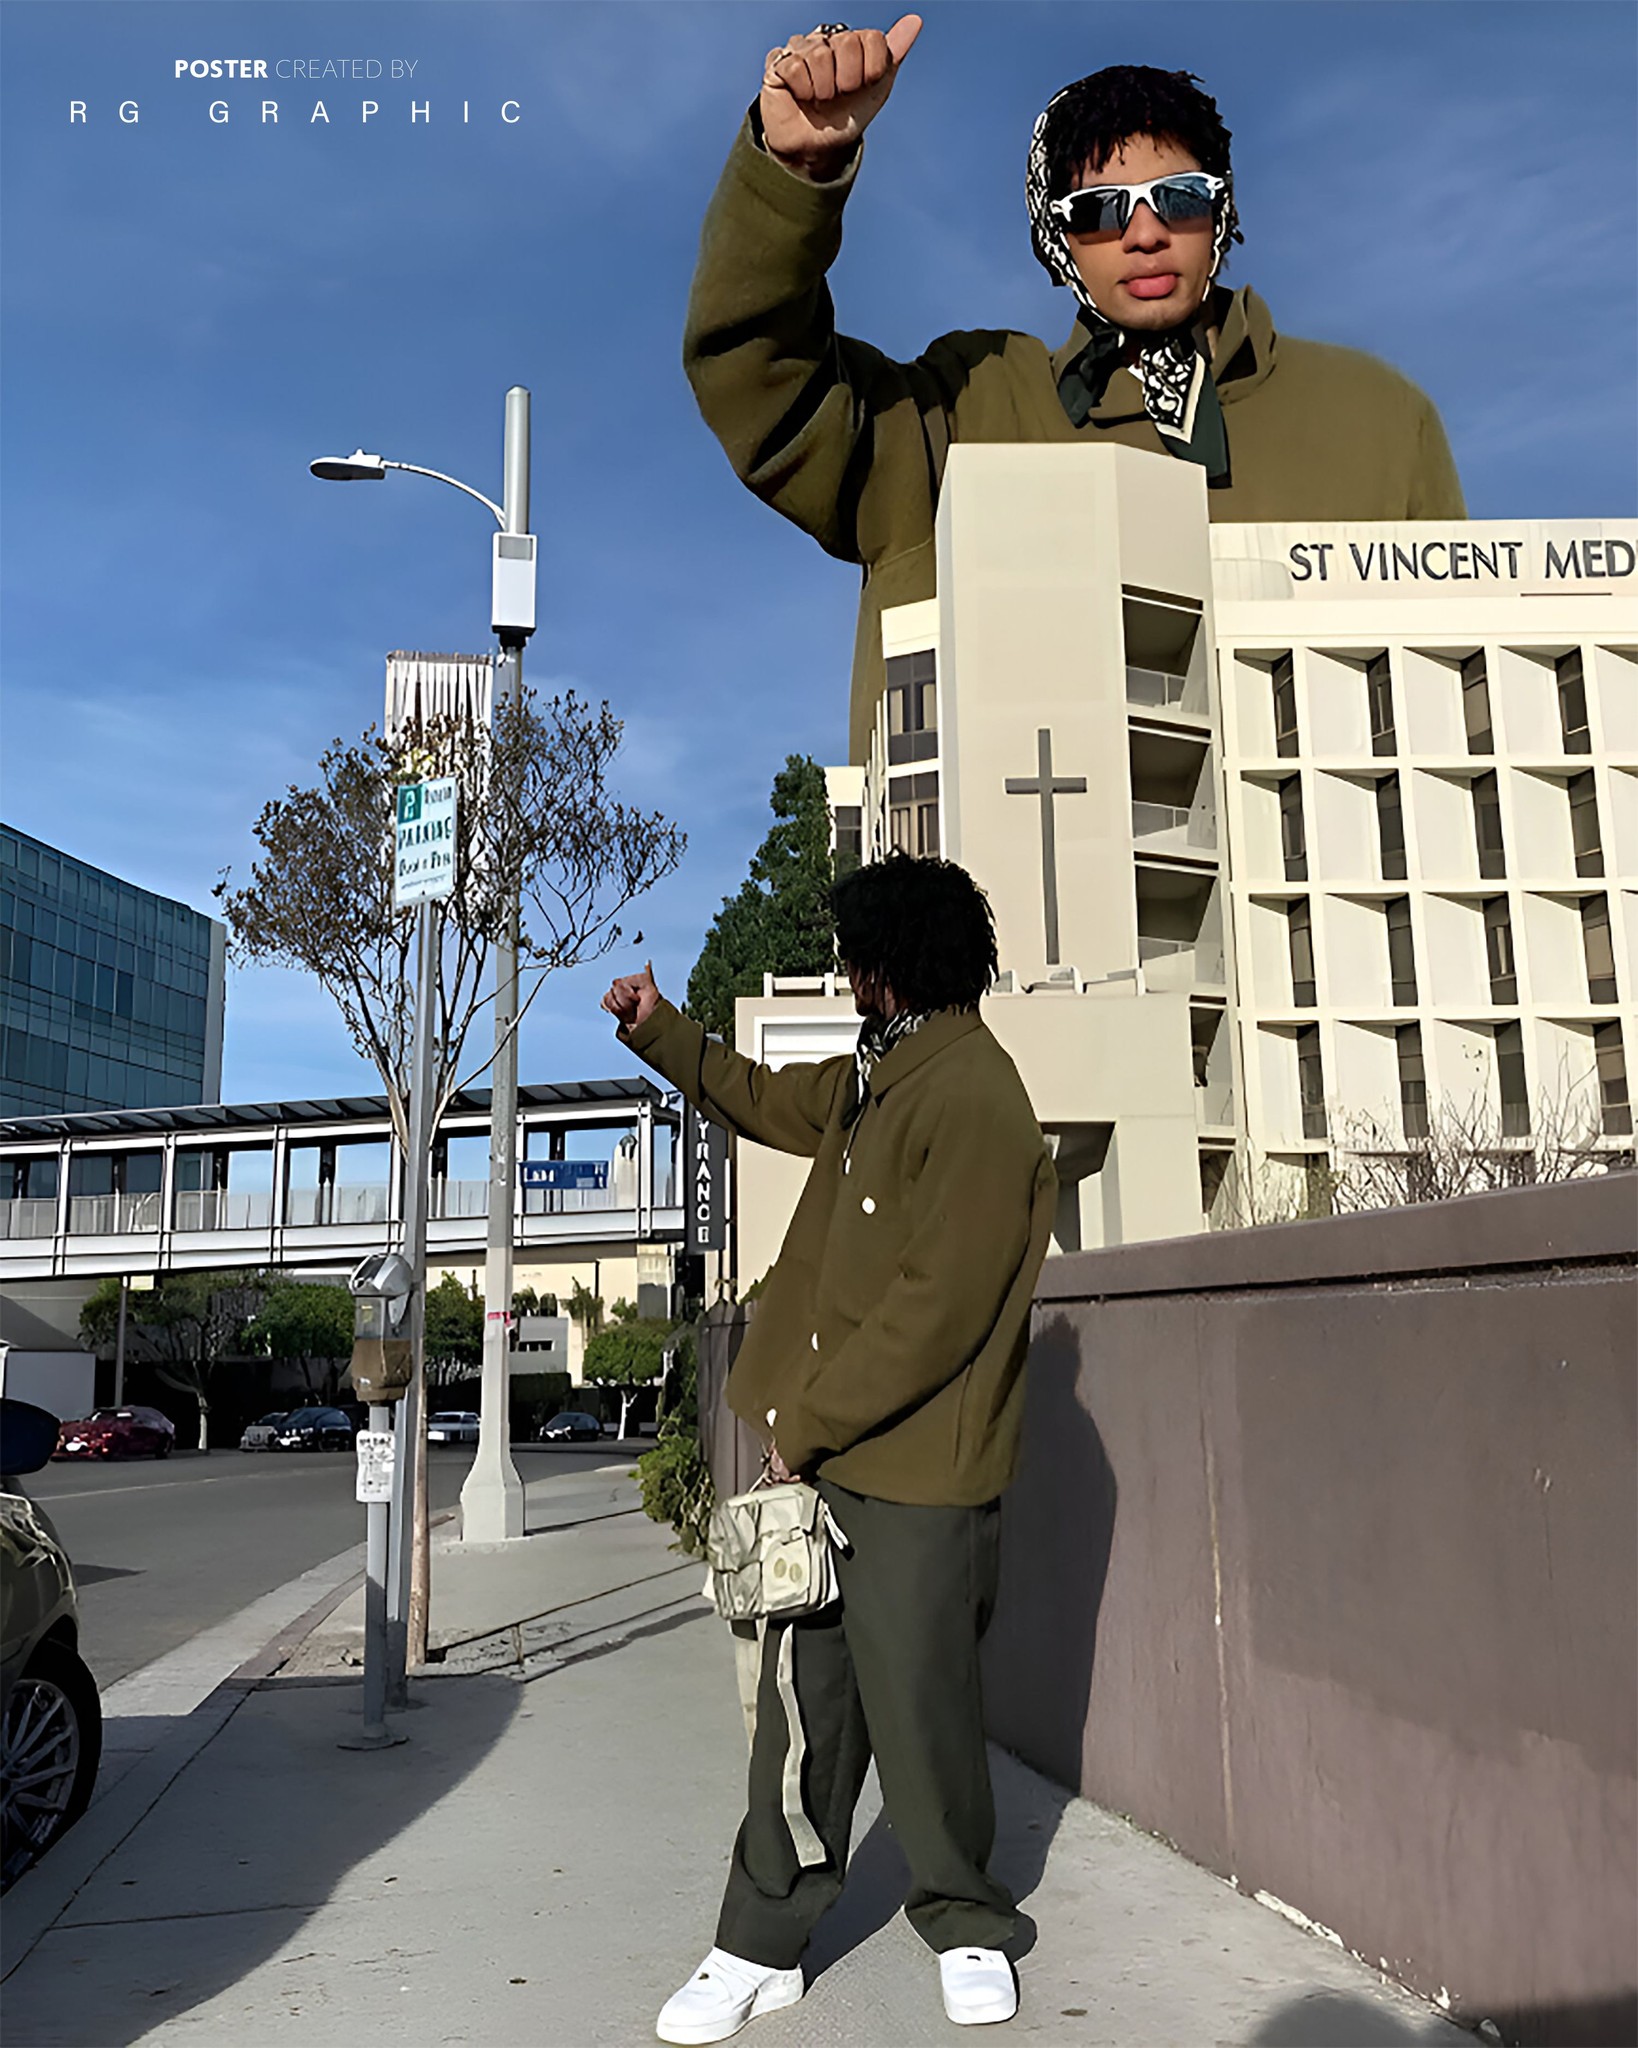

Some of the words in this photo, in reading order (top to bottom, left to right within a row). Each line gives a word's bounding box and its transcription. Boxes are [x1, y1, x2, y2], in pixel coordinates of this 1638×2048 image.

[1289, 543, 1334, 581] ST
[1348, 541, 1524, 581] VINCENT
[1545, 539, 1638, 580] MED
